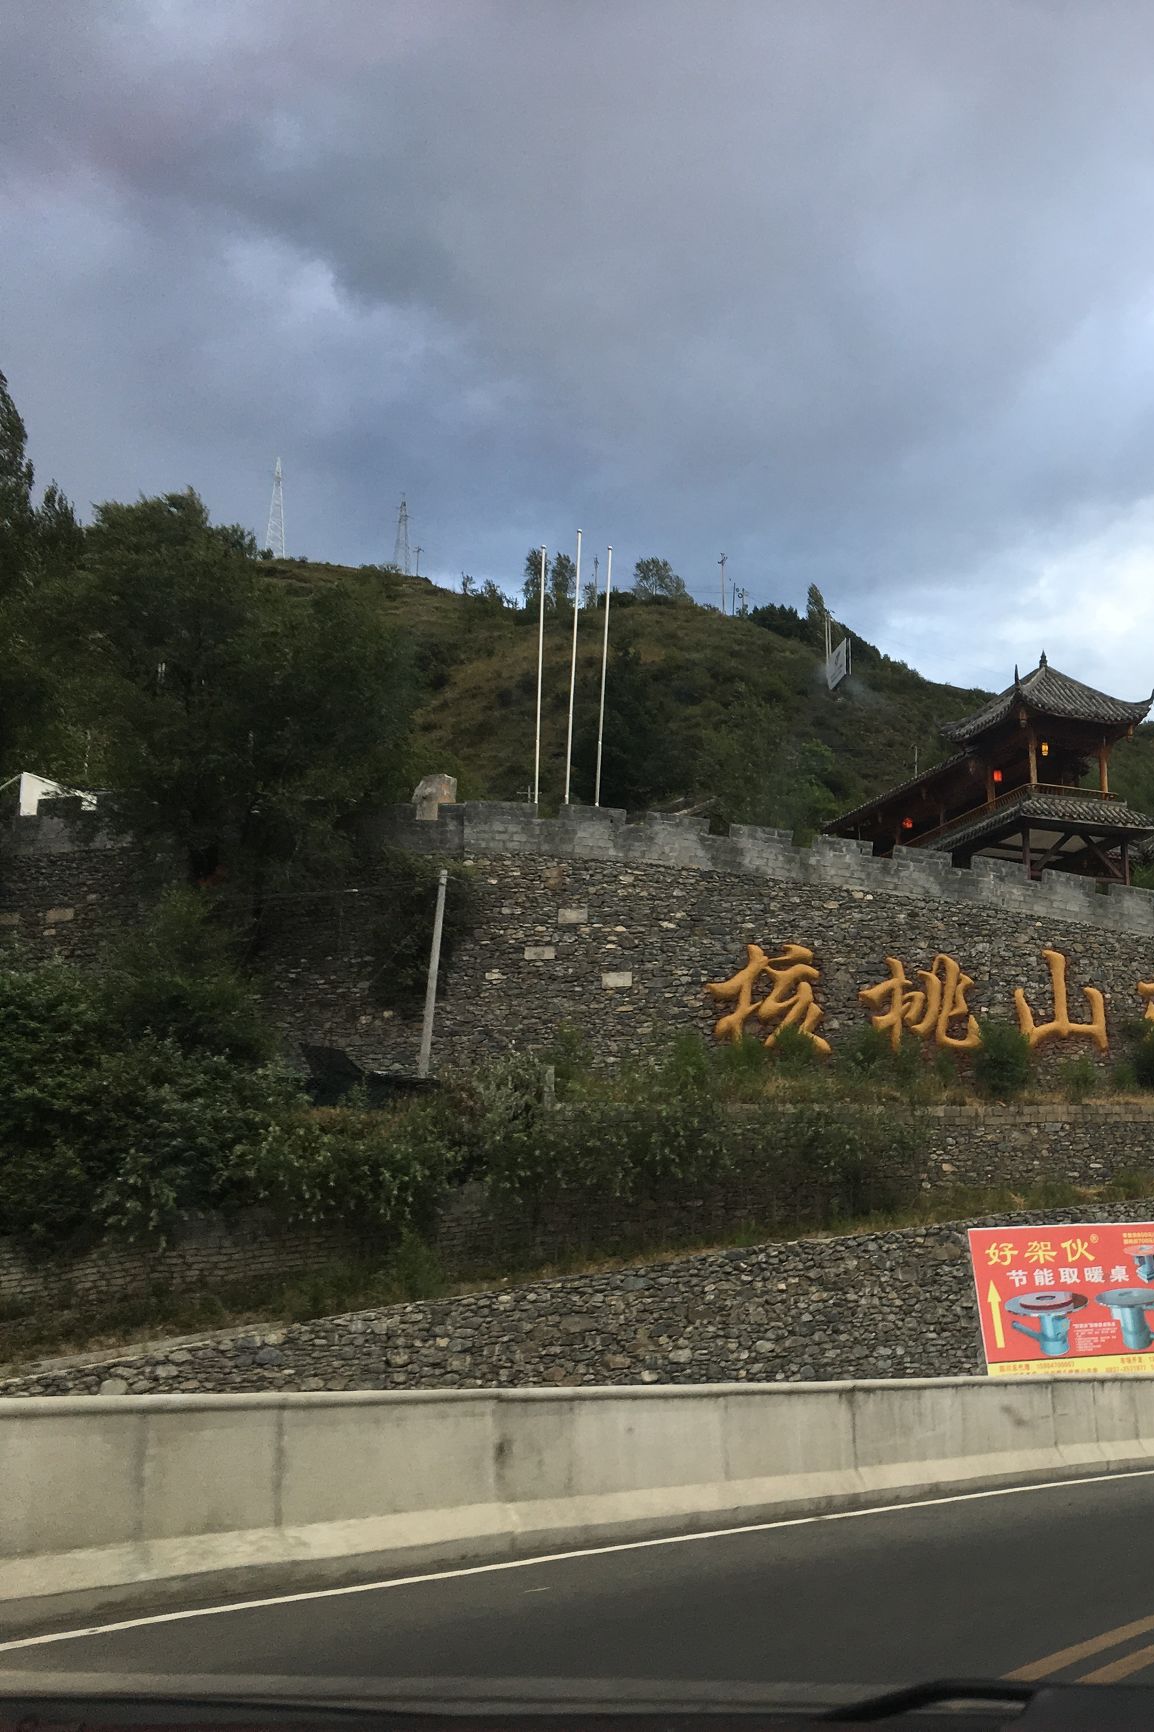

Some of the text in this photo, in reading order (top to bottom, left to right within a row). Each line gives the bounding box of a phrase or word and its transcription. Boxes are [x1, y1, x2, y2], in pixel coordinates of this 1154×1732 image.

[985, 1238, 1096, 1266] 好架伙
[1006, 1265, 1129, 1287] 节能取暖桌
